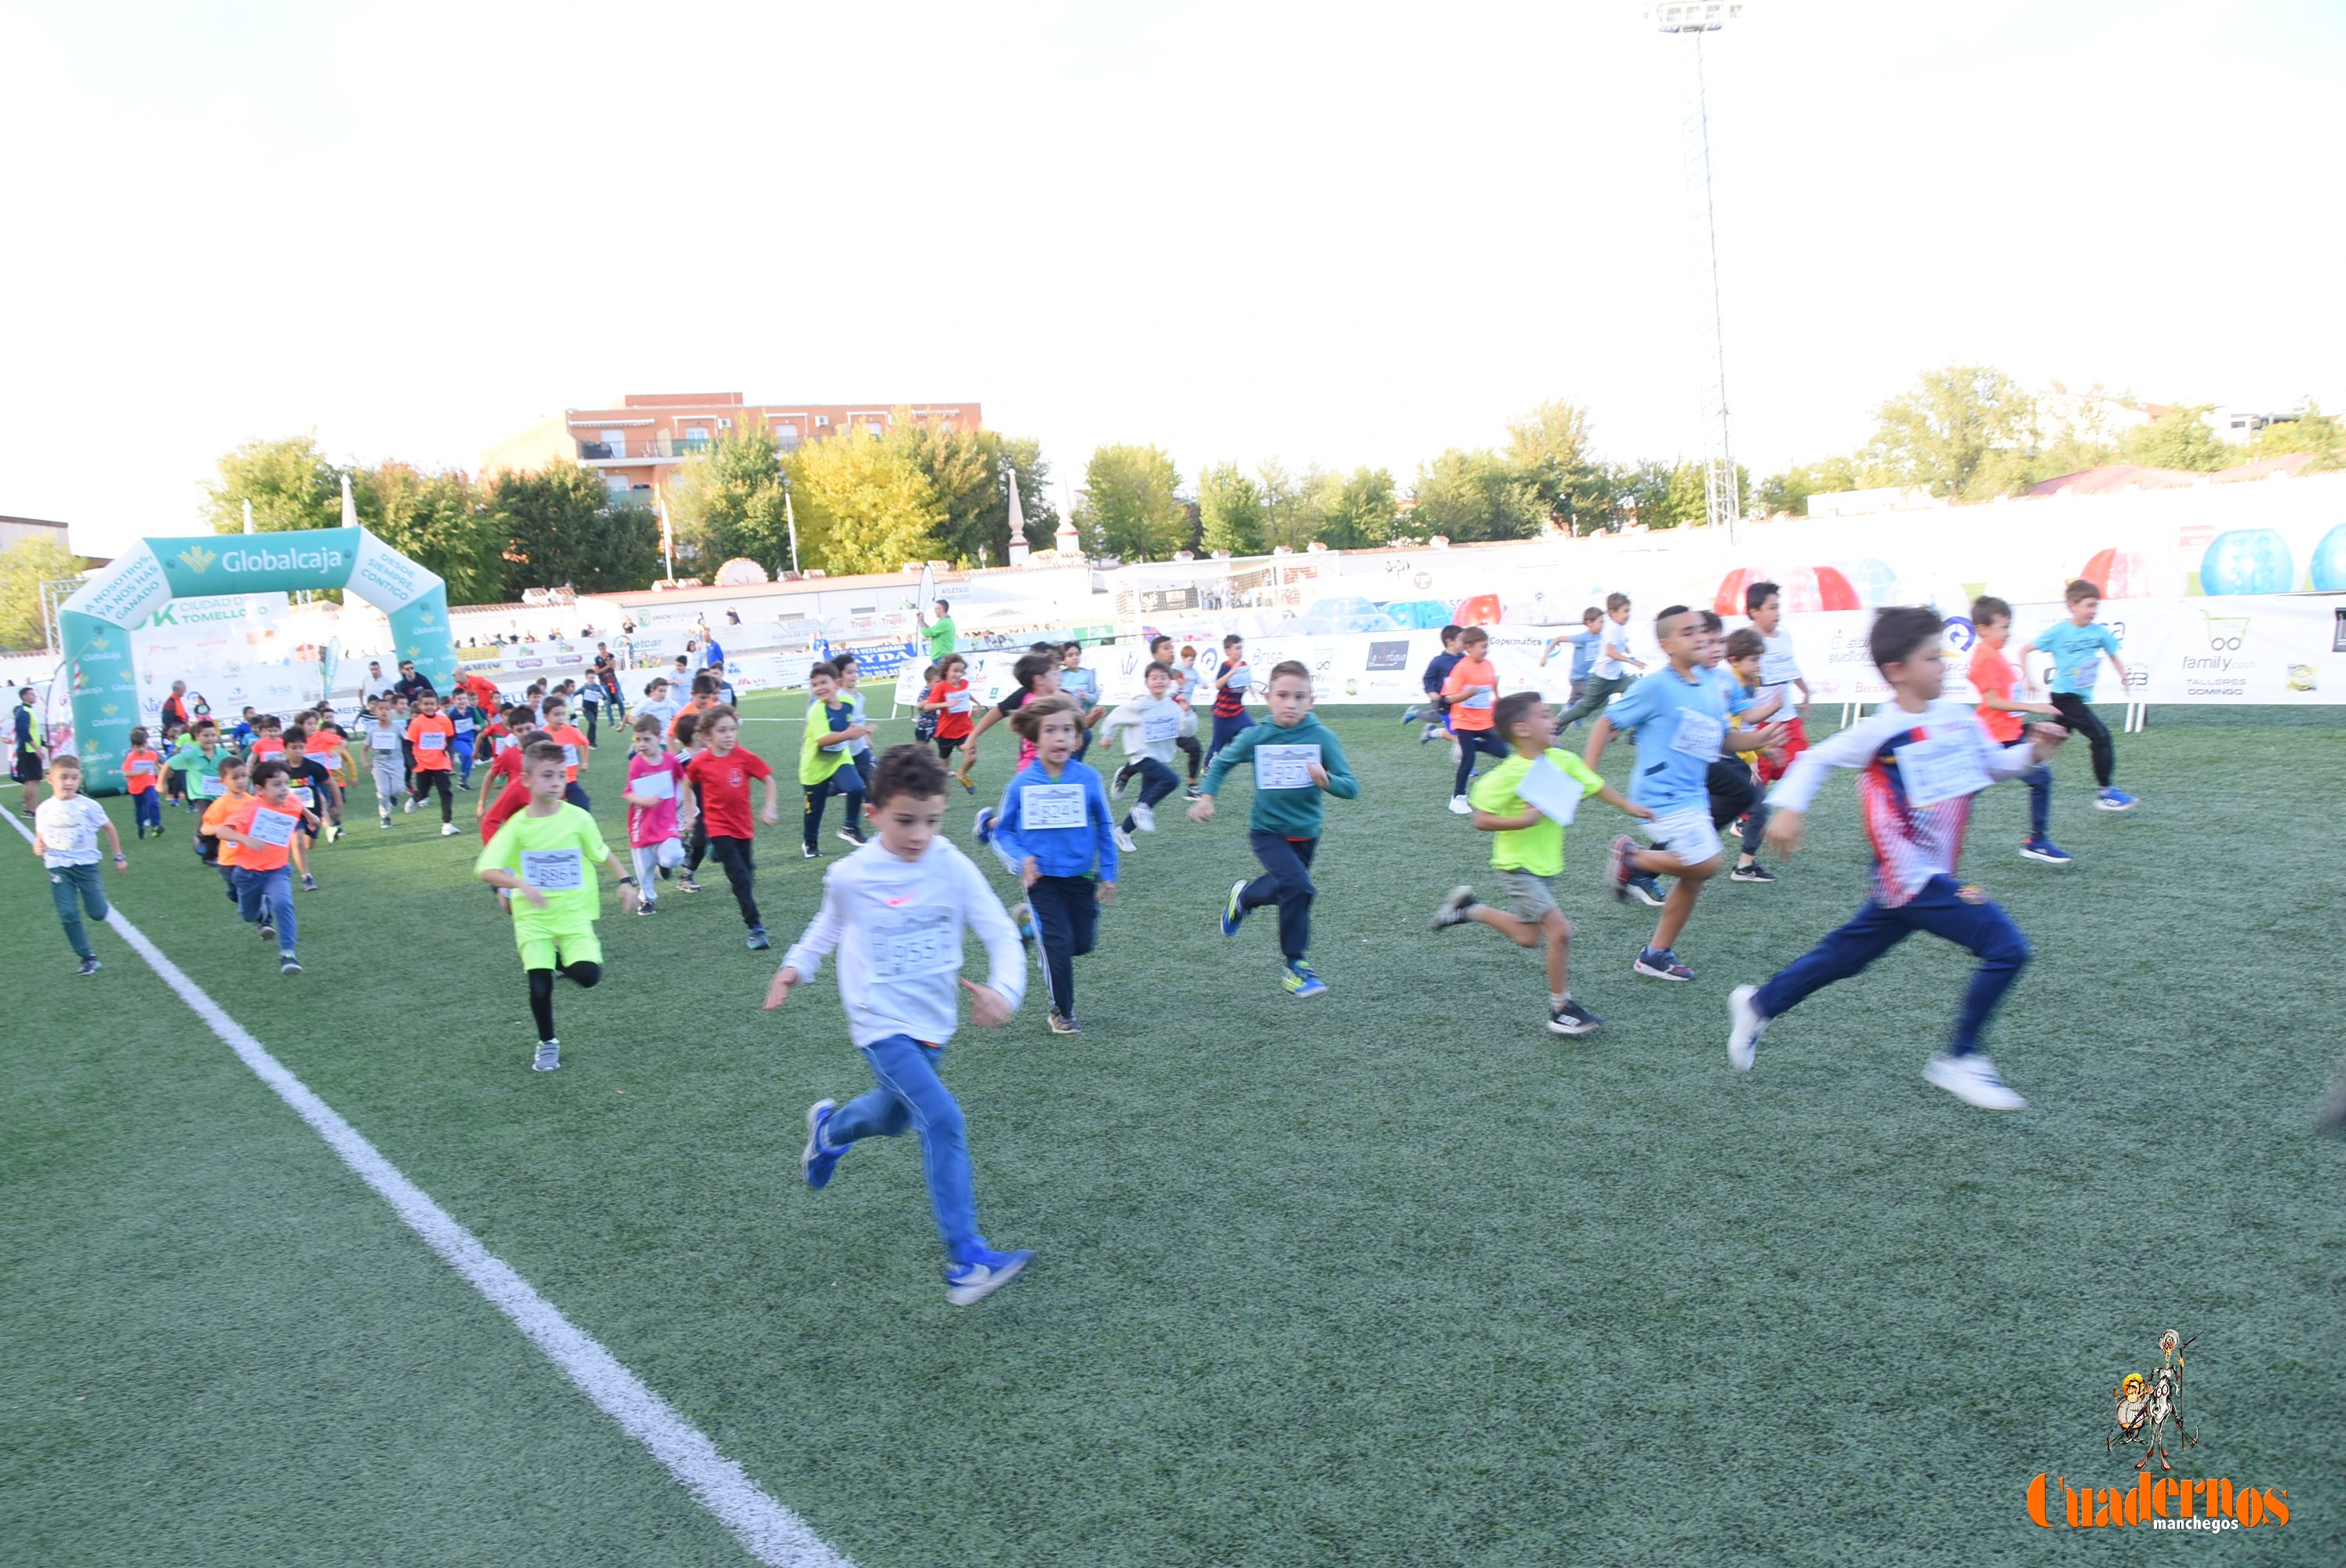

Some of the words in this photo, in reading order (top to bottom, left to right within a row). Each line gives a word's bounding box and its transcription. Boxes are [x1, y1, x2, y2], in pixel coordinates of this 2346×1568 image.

[222, 546, 342, 574] Globalcaja
[380, 553, 415, 578] DESDE
[93, 555, 153, 604] NOSOTROS,
[361, 568, 409, 601] CONTIGO
[367, 557, 415, 593] SIEMPRE,
[98, 603, 114, 617] YA
[112, 584, 137, 605] NOS
[135, 564, 158, 586] HAS
[180, 597, 231, 612] CIUDAD
[1489, 637, 1542, 646] Copermática
[1252, 648, 1283, 666] Brisa
[2182, 655, 2232, 672] family
